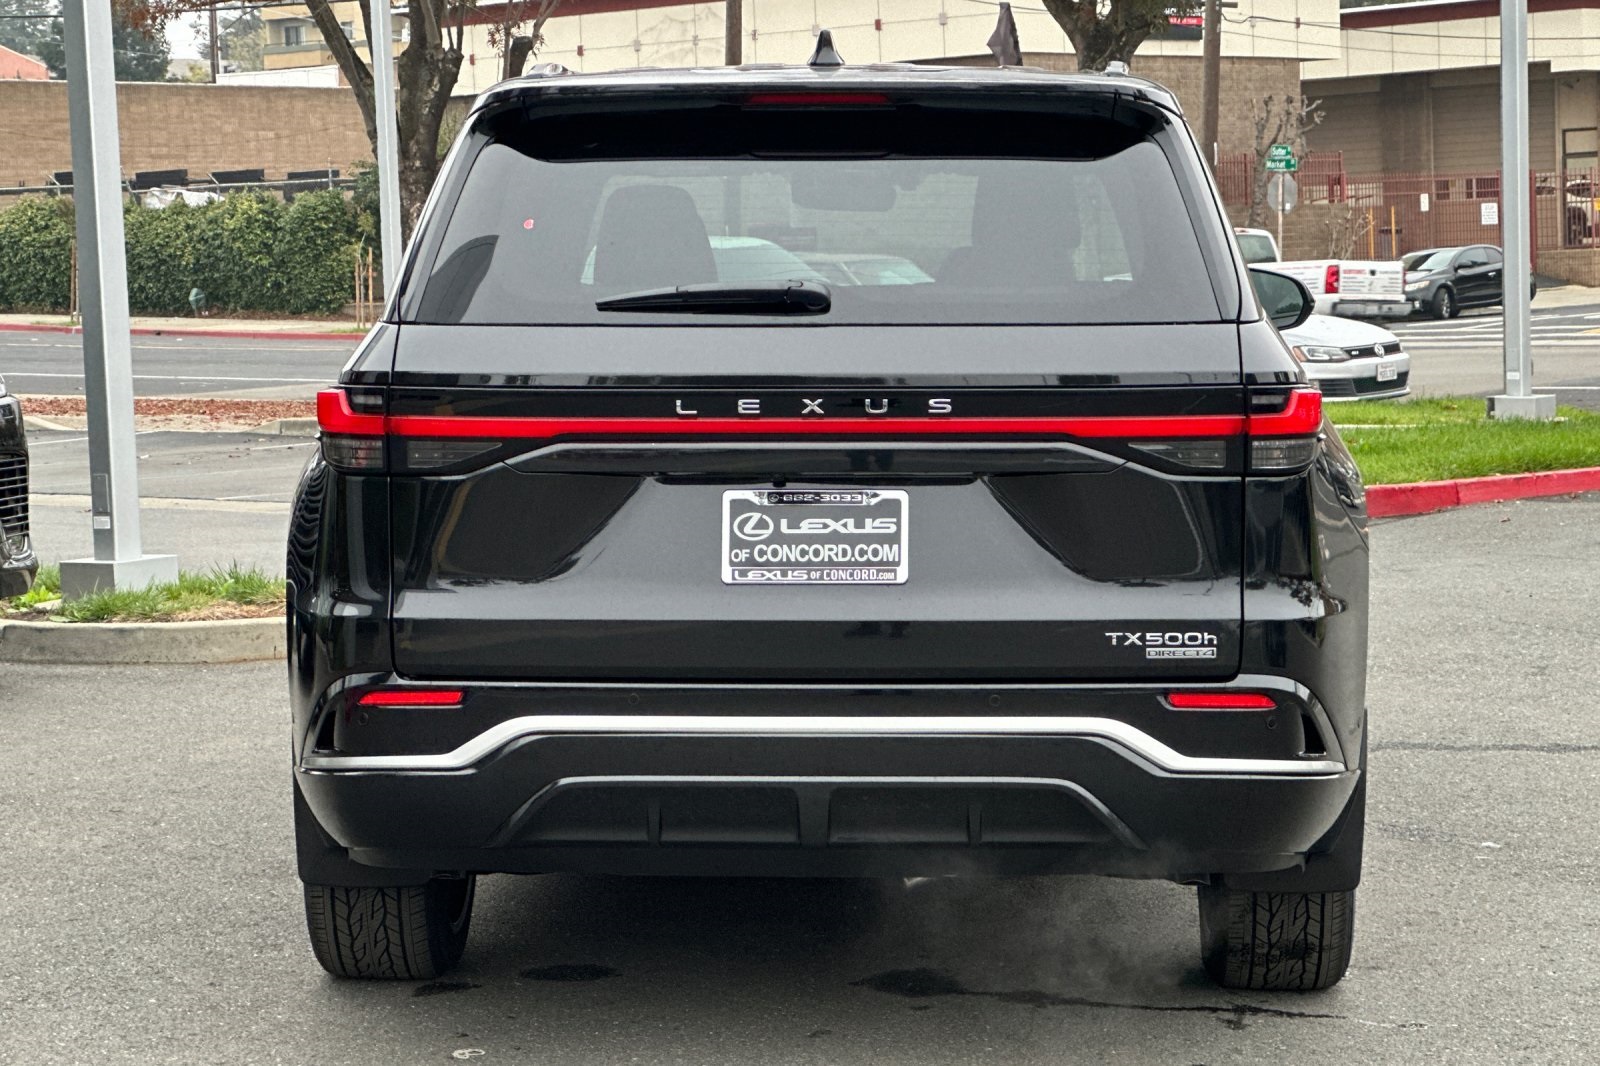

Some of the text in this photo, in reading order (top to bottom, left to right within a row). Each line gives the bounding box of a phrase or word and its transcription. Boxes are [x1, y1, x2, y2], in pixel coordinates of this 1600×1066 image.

[1266, 160, 1286, 169] Market
[676, 398, 952, 414] LEXUS
[780, 518, 897, 533] LEXUS
[731, 543, 899, 562] OF CONCORD.COM
[734, 570, 808, 580] LEXUS
[810, 571, 821, 579] OF
[1147, 649, 1215, 657] DIRECT4
